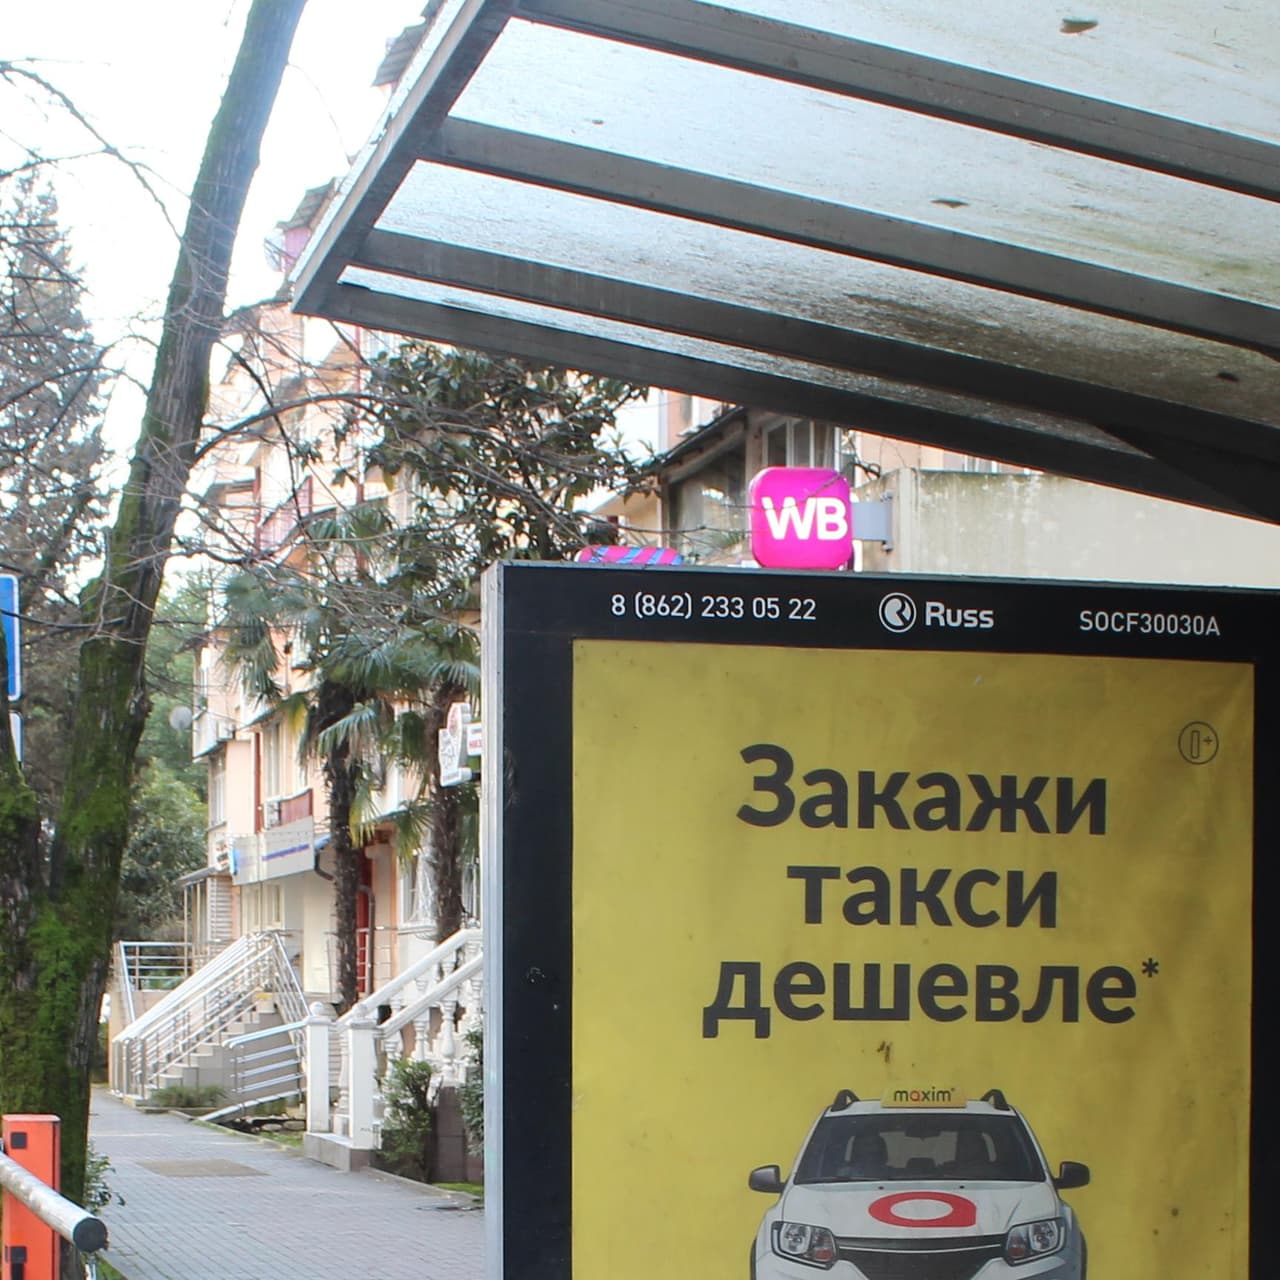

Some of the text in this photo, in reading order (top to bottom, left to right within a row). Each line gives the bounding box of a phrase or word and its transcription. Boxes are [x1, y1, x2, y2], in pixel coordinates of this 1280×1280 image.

[761, 496, 849, 541] WB
[611, 591, 817, 621] 8 (862) 233 05 22
[925, 602, 995, 629] Russ
[1078, 609, 1222, 637] SOCF30030A
[736, 744, 1108, 836] Закажи
[787, 865, 1058, 929] такси
